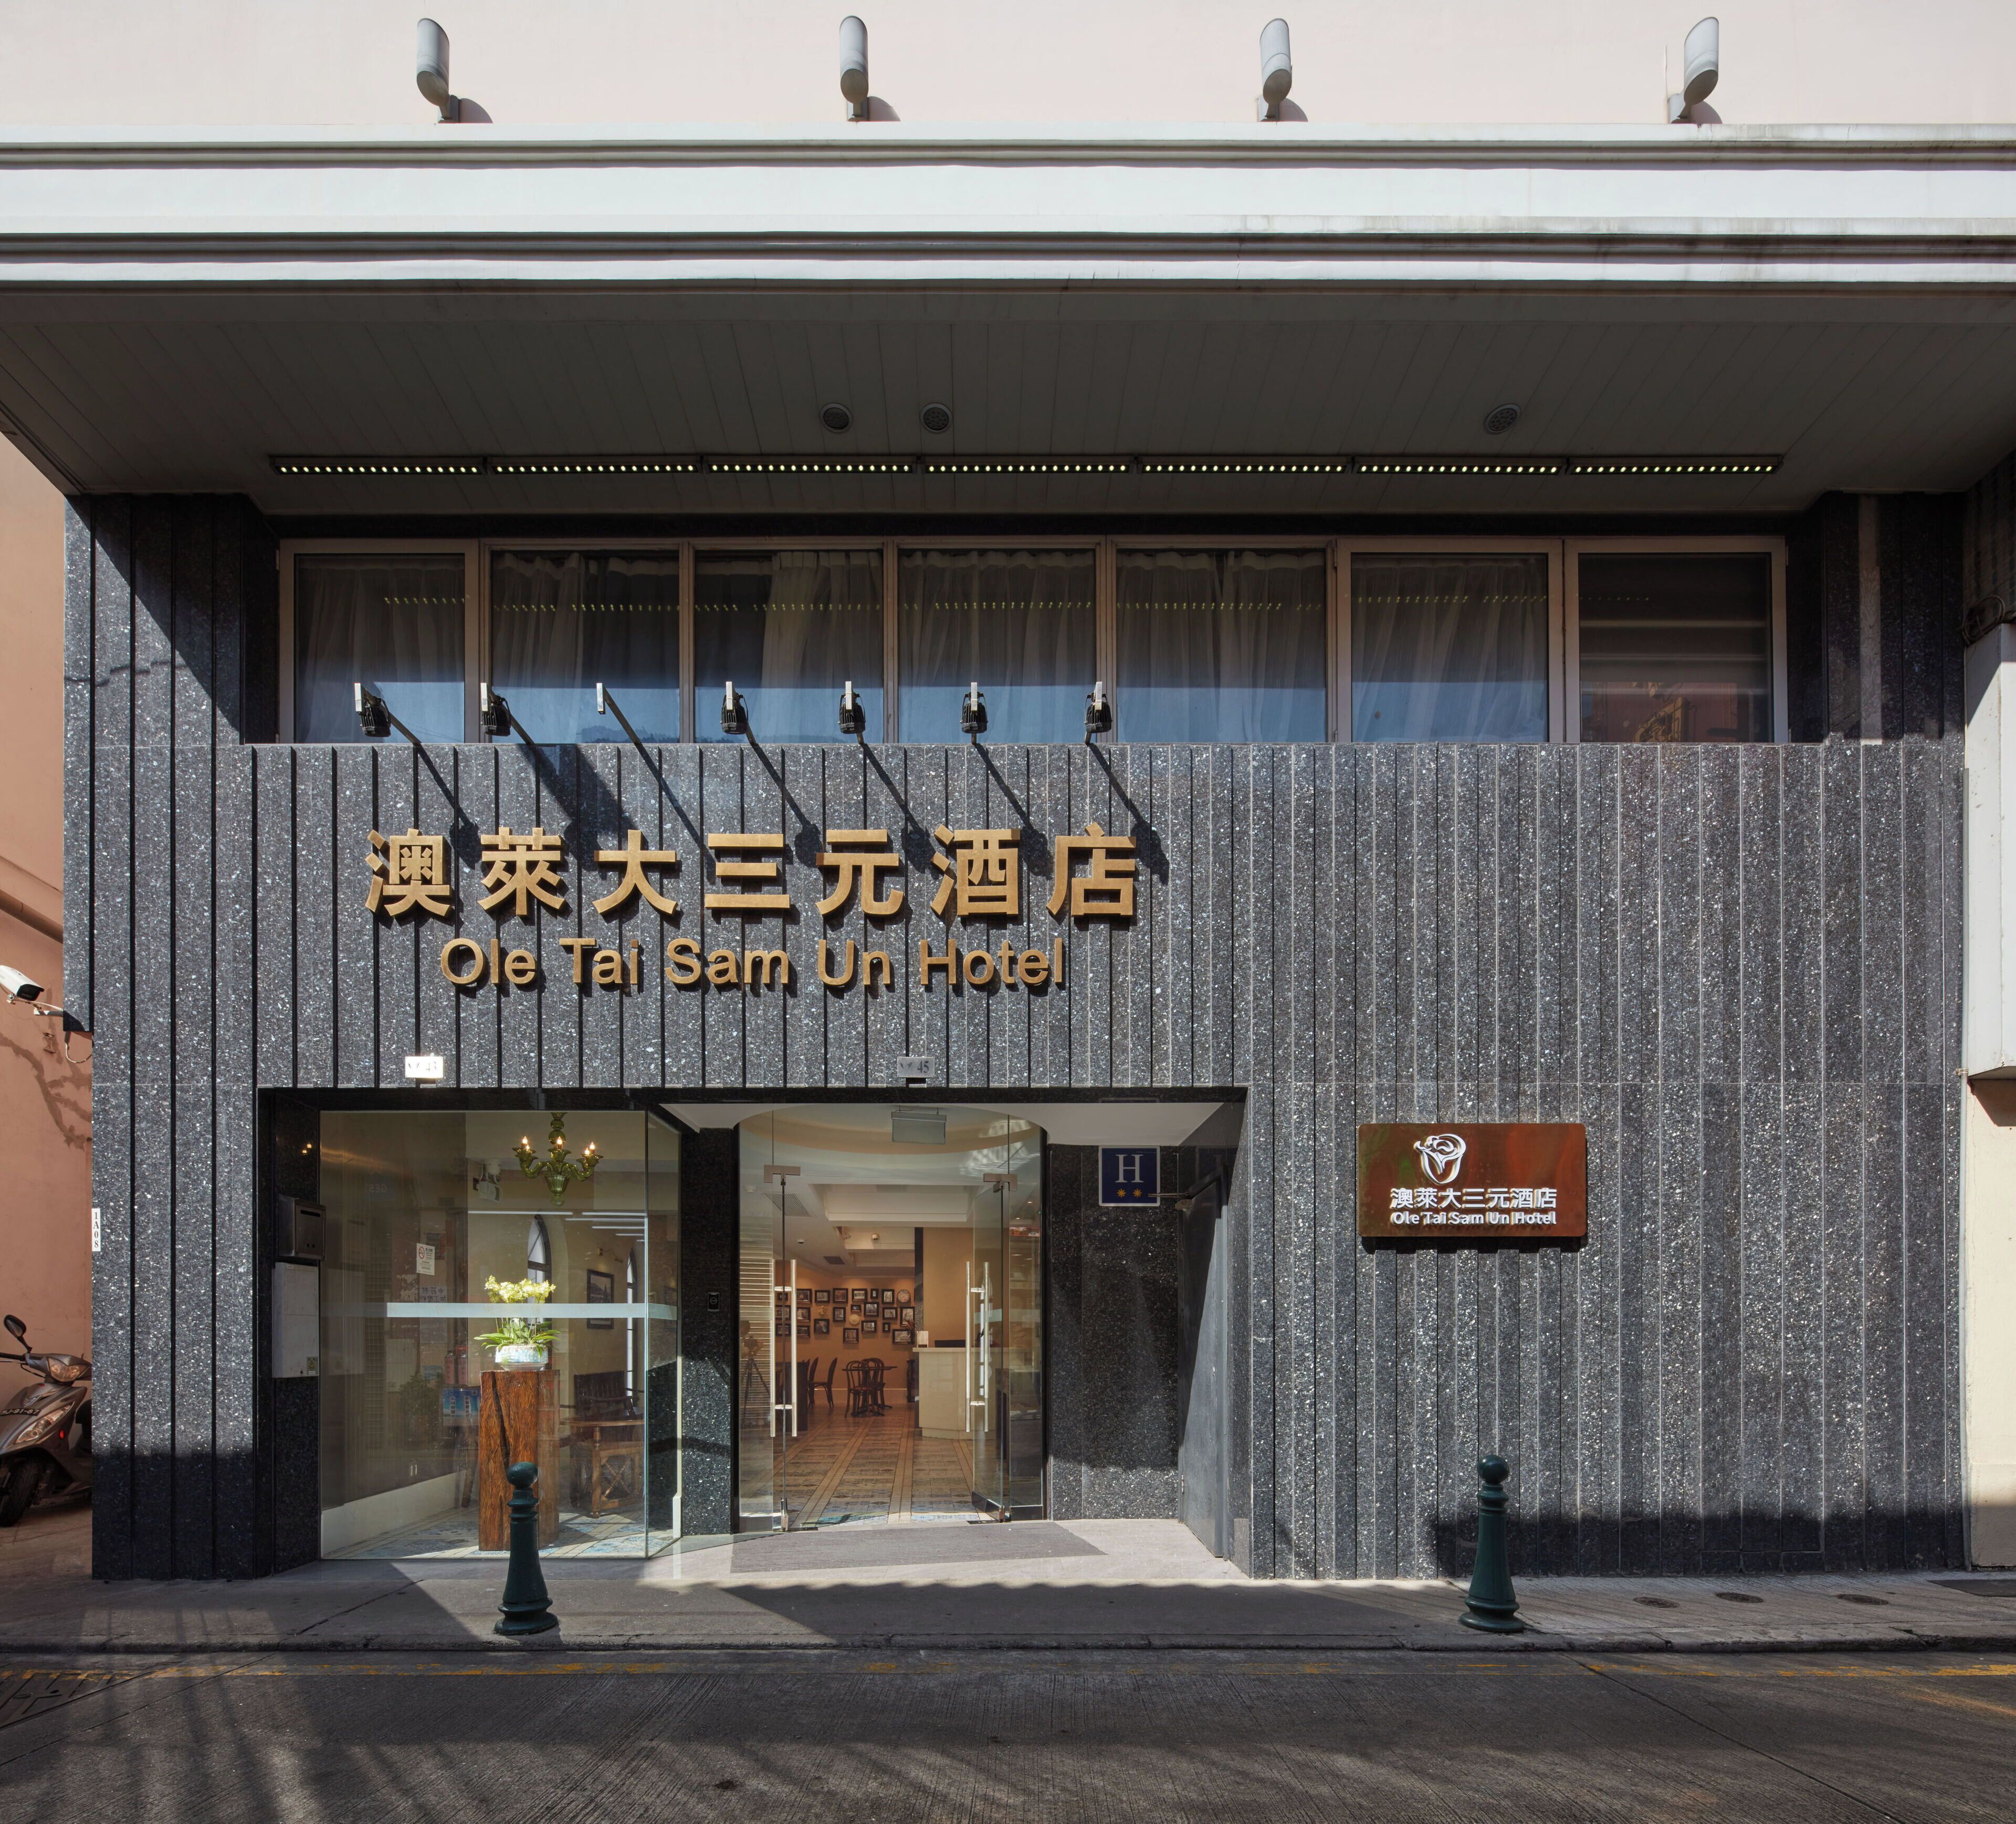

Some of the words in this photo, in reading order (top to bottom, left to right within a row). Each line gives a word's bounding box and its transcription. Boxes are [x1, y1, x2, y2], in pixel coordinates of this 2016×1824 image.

[365, 822, 1137, 917] 澳萊大三元酒店
[440, 938, 537, 985] Ole
[559, 938, 639, 985] Tai
[665, 938, 789, 985] Sam
[817, 939, 891, 987] Un
[919, 937, 1063, 986] Hotel
[917, 1060, 929, 1074] 45
[1115, 1154, 1144, 1183] H
[1390, 1188, 1557, 1209] 澳萊大三元酒店
[1391, 1211, 1420, 1225] Ole
[1420, 1212, 1447, 1225] Tai
[1448, 1212, 1484, 1225] Sam
[1486, 1212, 1509, 1225] Un
[1511, 1211, 1557, 1225] Hotel
